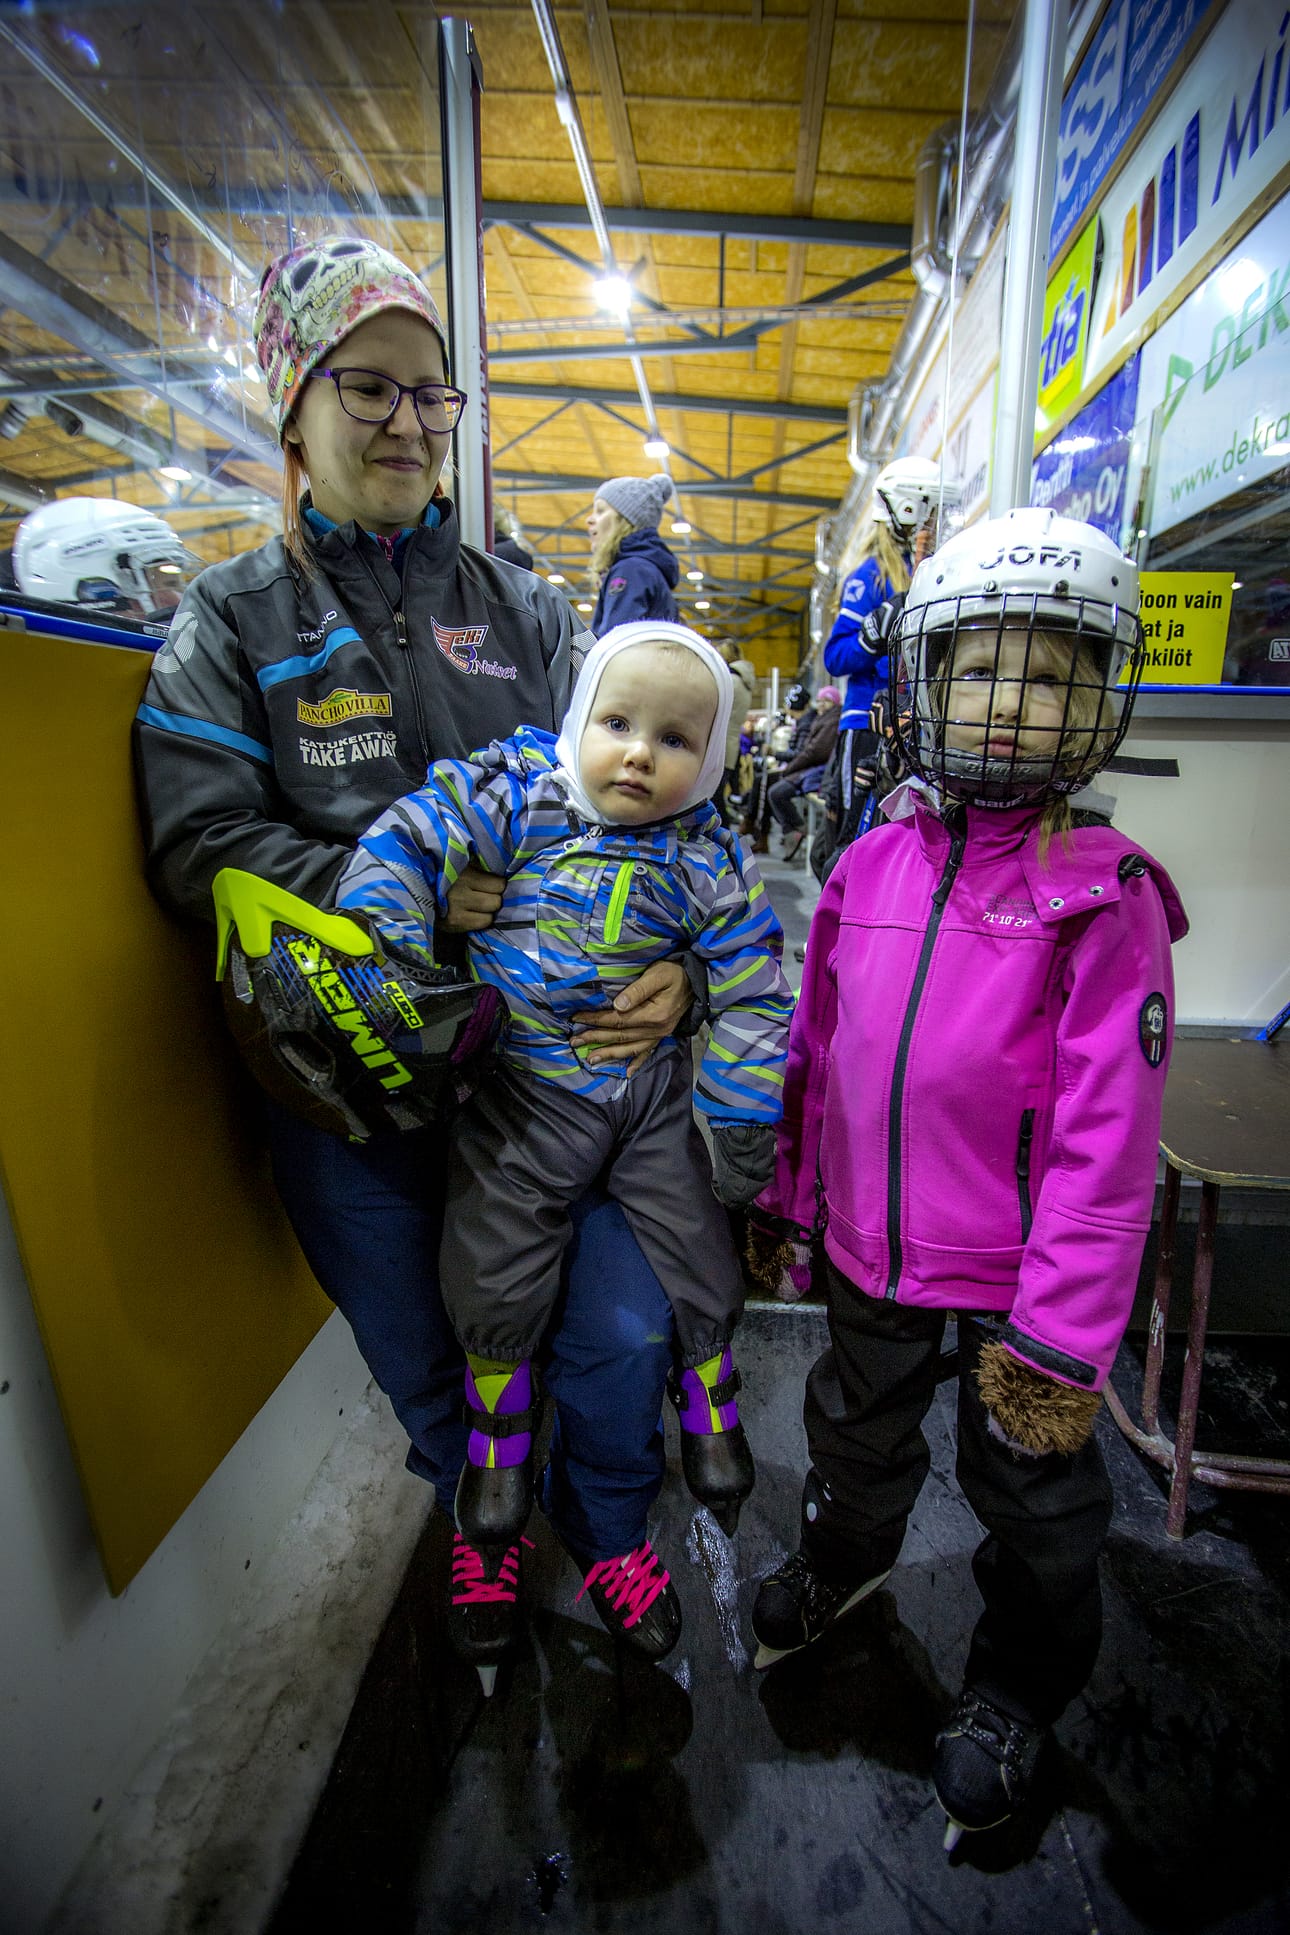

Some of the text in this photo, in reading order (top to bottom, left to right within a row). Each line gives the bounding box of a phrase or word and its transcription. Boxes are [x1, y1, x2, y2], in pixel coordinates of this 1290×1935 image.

[1211, 10, 1290, 208] Mi
[1204, 262, 1290, 394] DEK
[1170, 411, 1290, 503] www.dekra
[979, 545, 1082, 572] JOFA
[1140, 589, 1222, 609] ioon vain
[1166, 619, 1185, 641] ja
[472, 660, 518, 680] Naiset
[300, 697, 388, 721] PANCHO VILLA
[300, 731, 397, 749] KATUKEITTIÖ
[300, 739, 397, 767] TAKE AWAY
